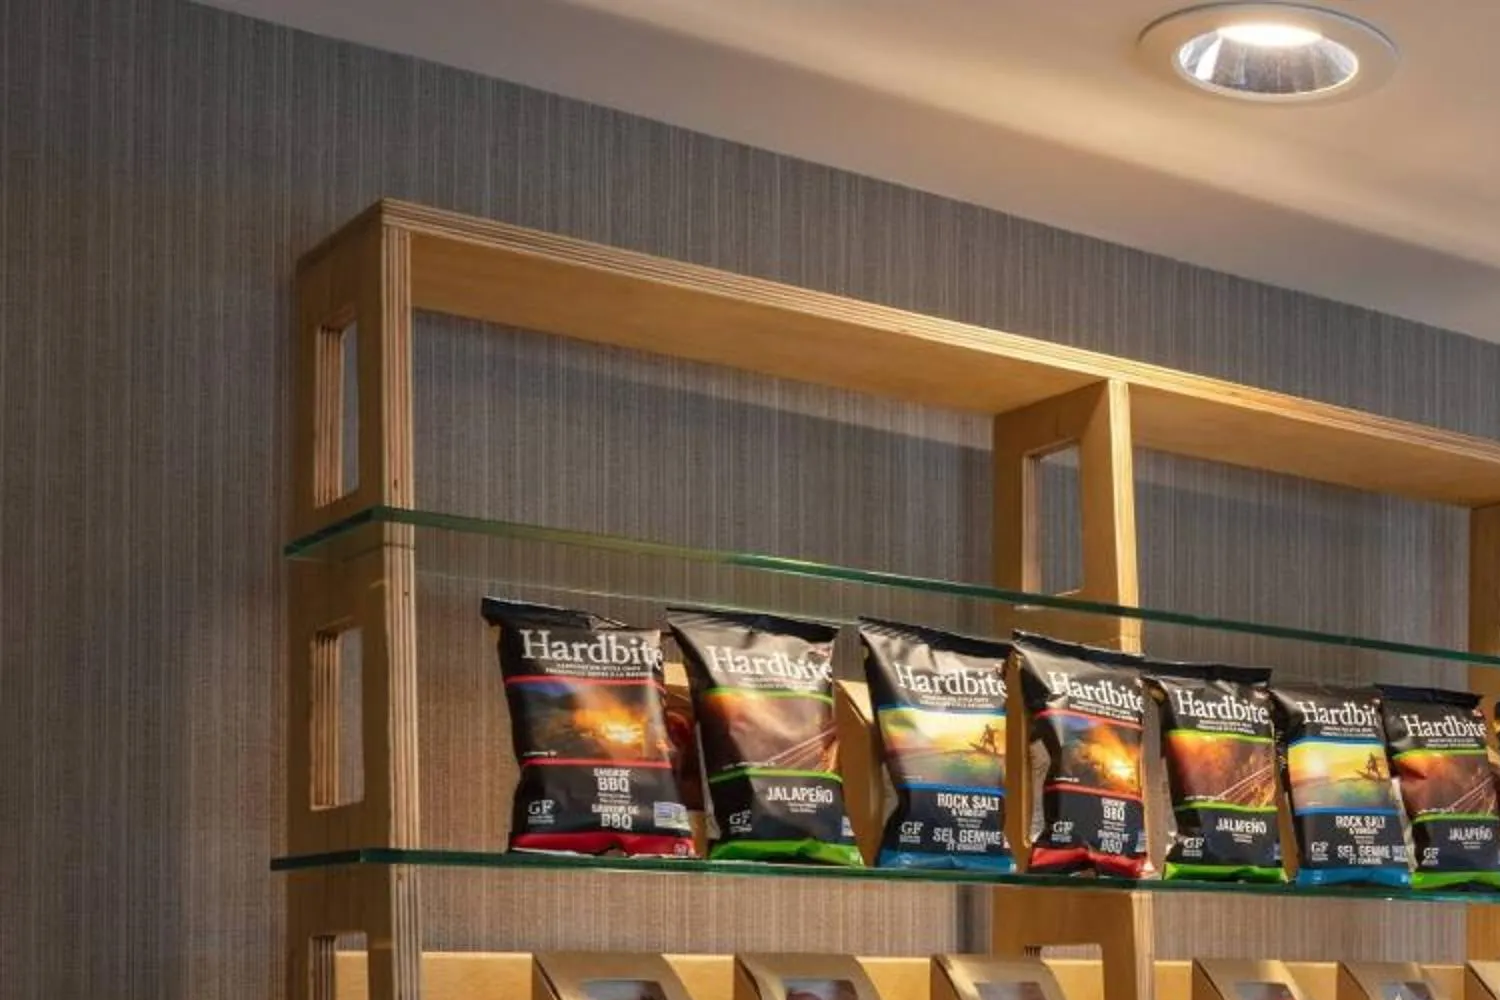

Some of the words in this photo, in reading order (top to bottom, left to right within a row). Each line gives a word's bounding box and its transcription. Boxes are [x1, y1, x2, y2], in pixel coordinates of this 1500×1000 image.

[520, 629, 664, 671] Hardbite
[704, 646, 833, 682] Hardbite
[894, 662, 1008, 698] Hardbite
[1047, 671, 1144, 713] Hardbite
[1175, 689, 1270, 724] Hardbite
[1400, 714, 1488, 739] Hardbite
[597, 777, 630, 793] BBQ
[767, 785, 833, 803] JALAPEÑO
[937, 792, 970, 809] ROCK
[972, 796, 1000, 811] SALT
[600, 813, 633, 830] BBQ
